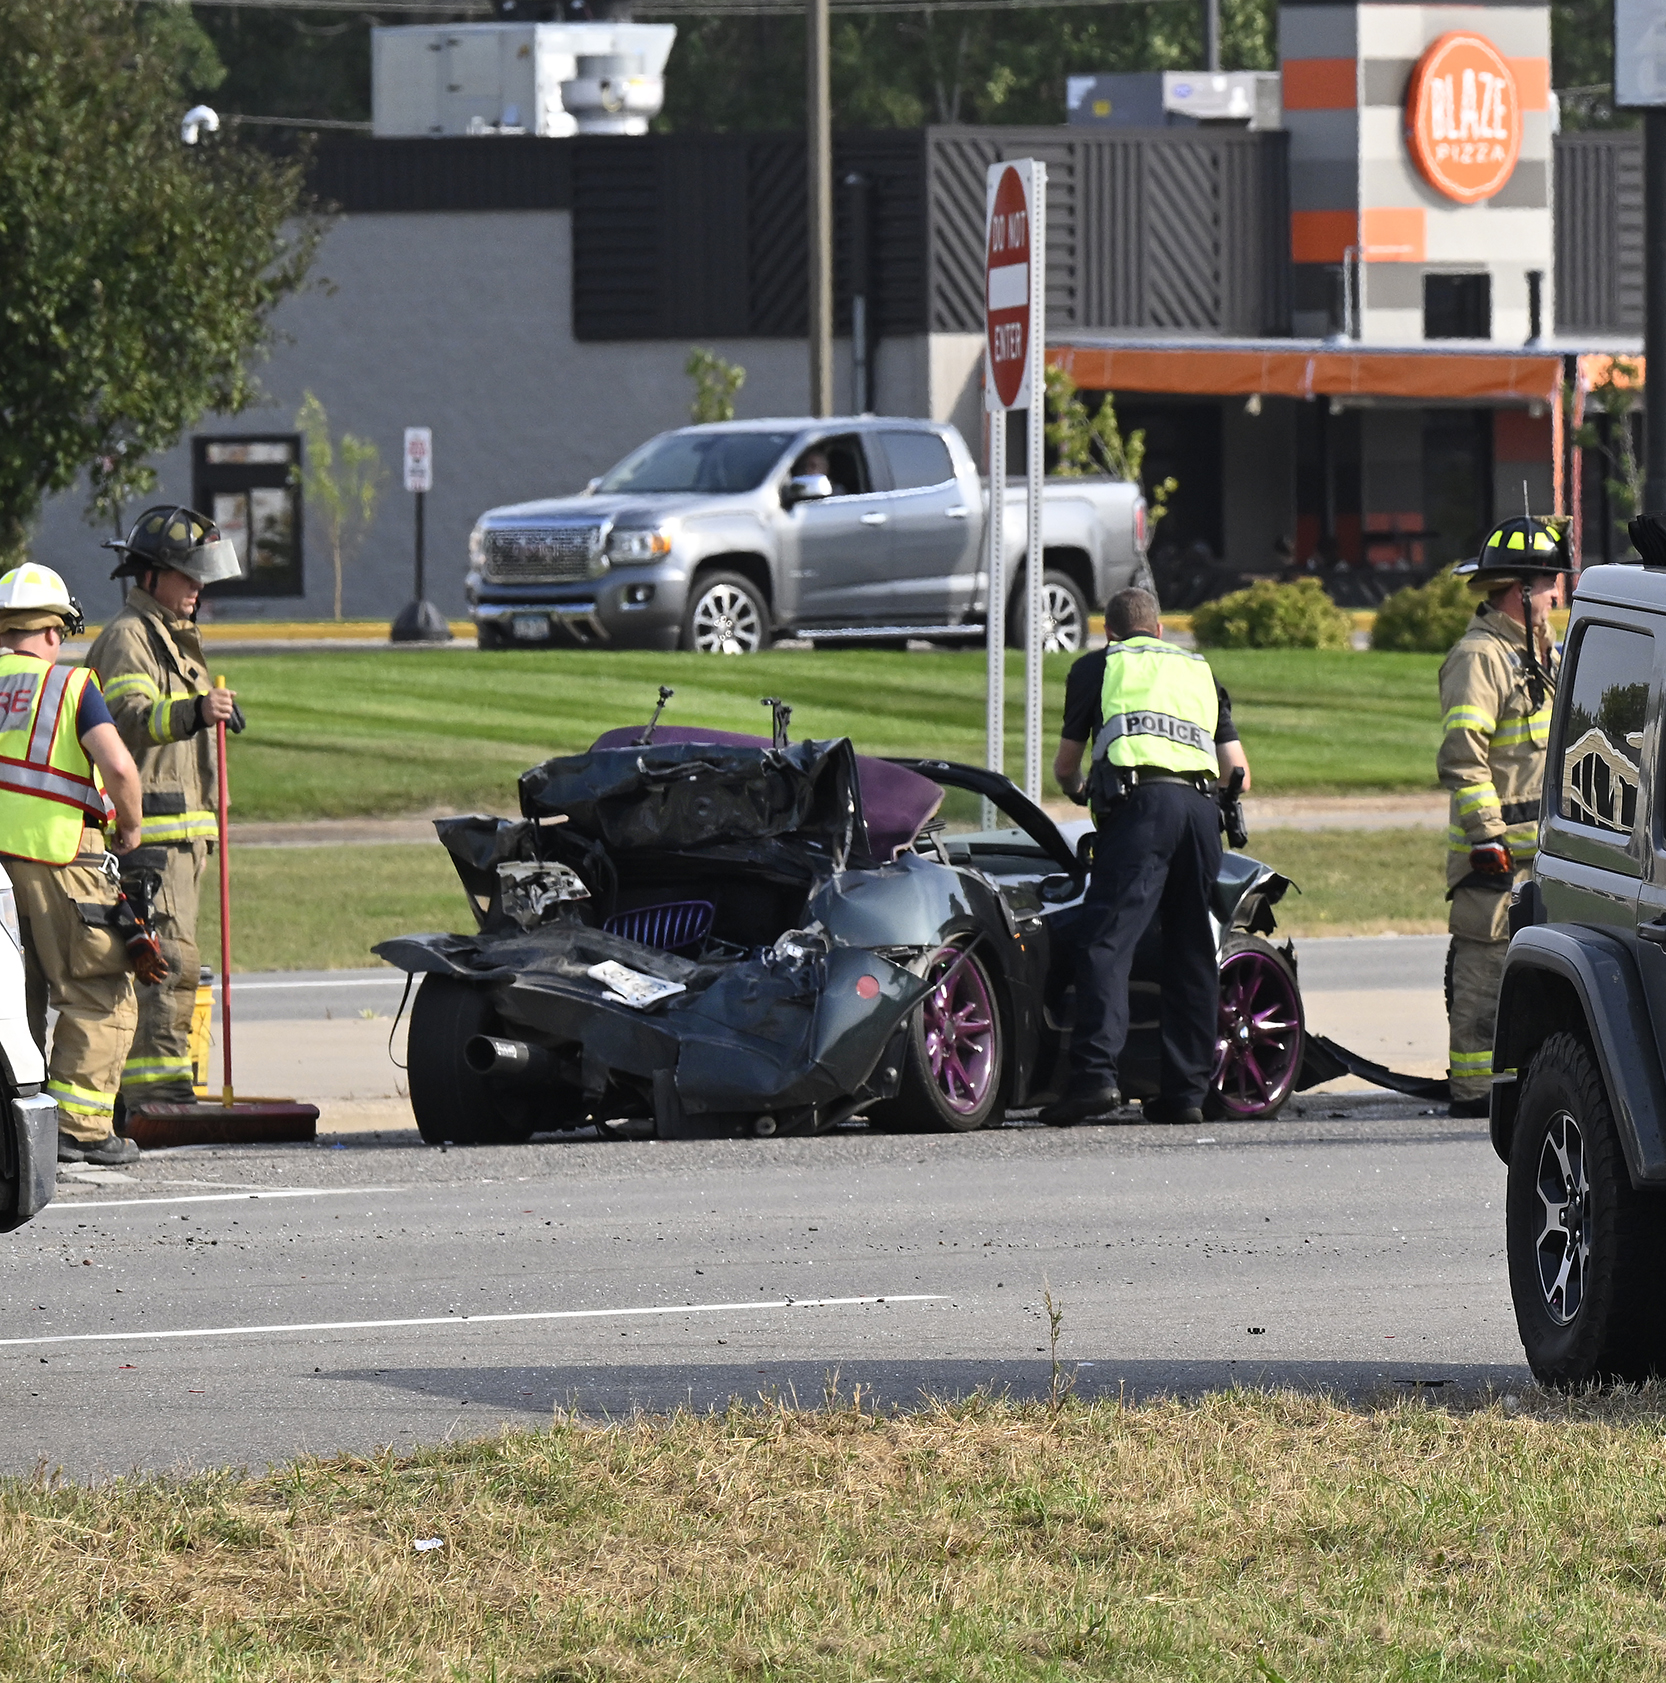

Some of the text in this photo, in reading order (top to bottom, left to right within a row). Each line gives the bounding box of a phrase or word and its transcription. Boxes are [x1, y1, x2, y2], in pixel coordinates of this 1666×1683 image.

[1431, 68, 1507, 140] BLAZE
[1435, 142, 1506, 164] PIZZA
[992, 210, 1026, 252] DO NOT
[995, 322, 1022, 362] ENTER
[1126, 715, 1201, 744] POLICE
